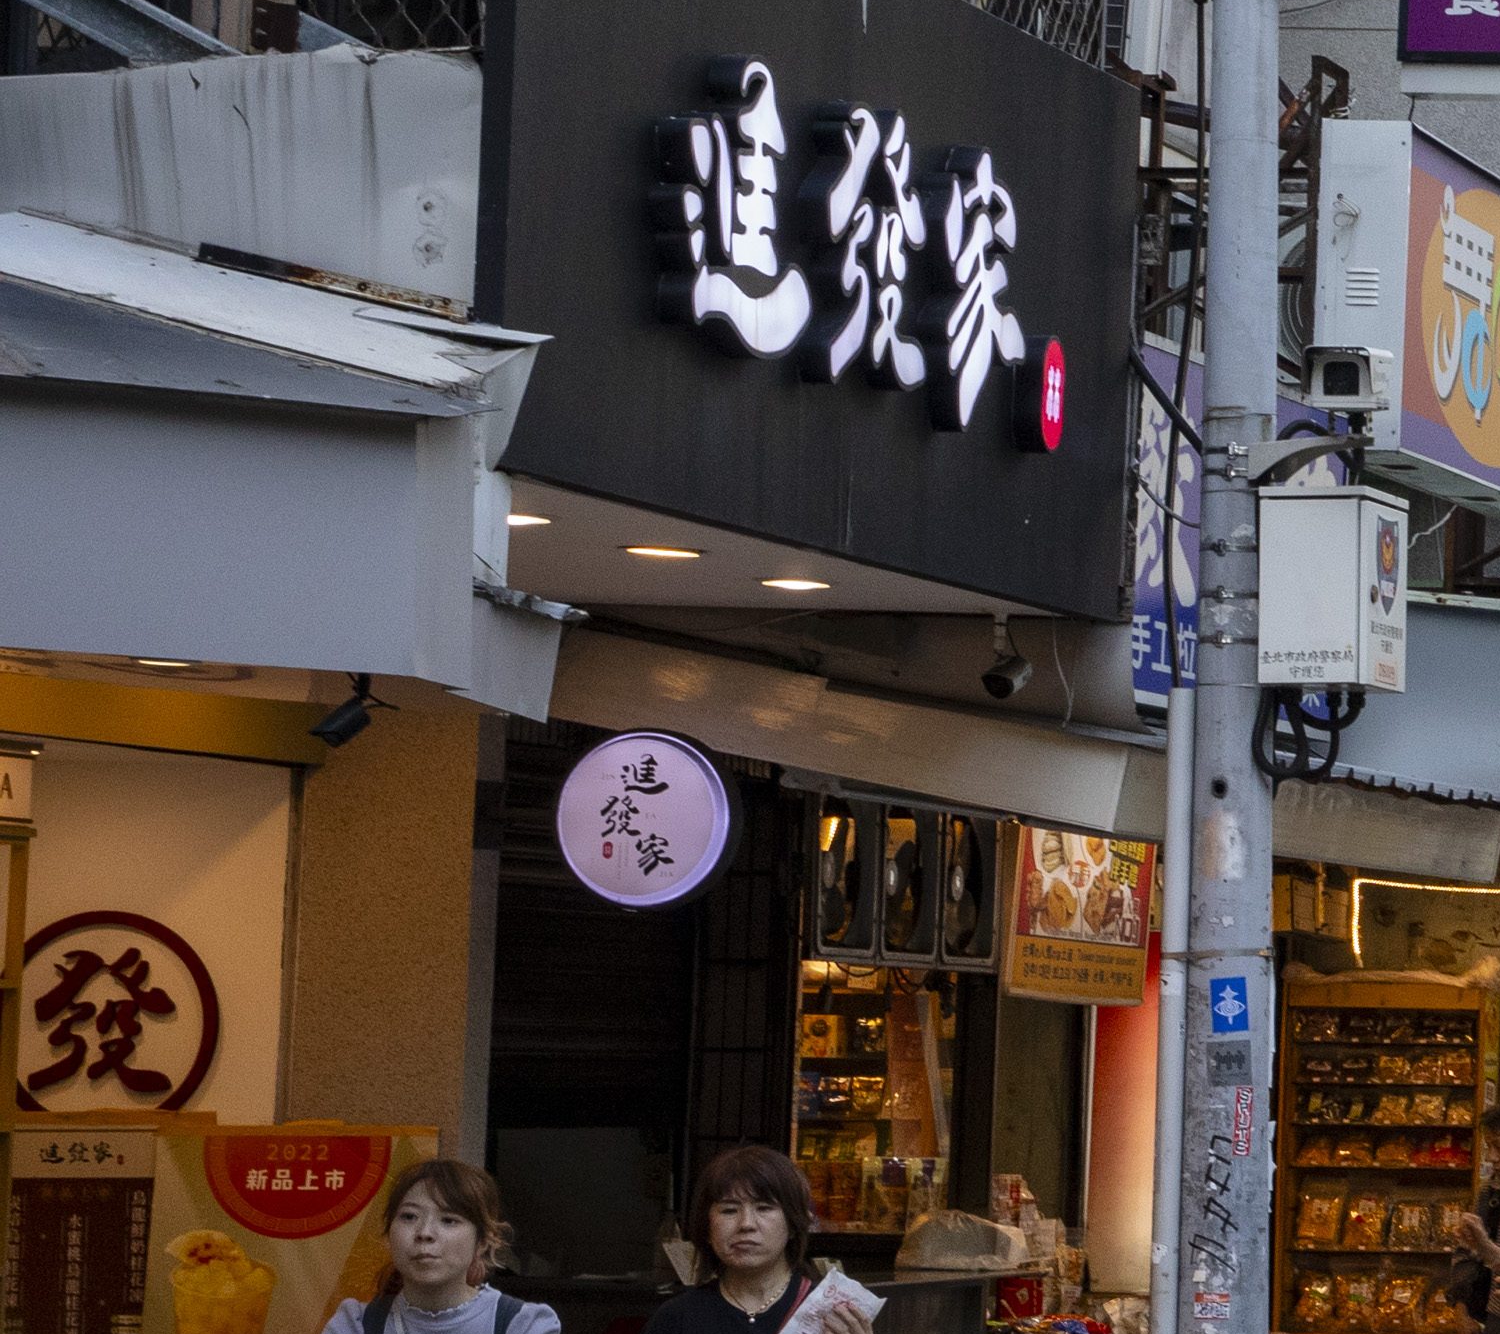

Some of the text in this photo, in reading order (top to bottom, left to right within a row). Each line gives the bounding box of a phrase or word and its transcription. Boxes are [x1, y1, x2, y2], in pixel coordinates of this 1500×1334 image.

[683, 61, 1027, 429] 進發家
[26, 946, 176, 1094] 發
[245, 1168, 346, 1192] 新品上市
[266, 1143, 331, 1162] 2022
